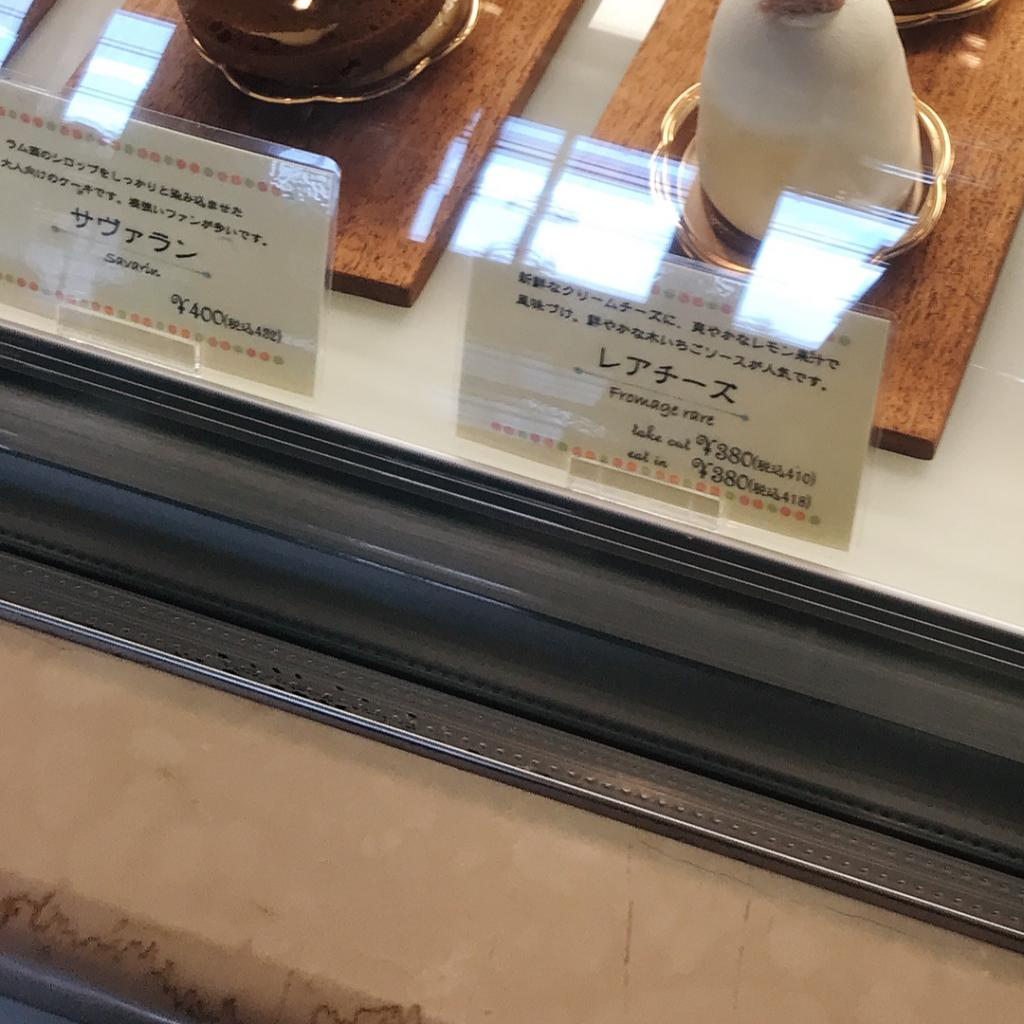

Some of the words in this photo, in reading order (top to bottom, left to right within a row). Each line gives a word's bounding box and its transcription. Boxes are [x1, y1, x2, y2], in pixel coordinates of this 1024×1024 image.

[70, 207, 198, 259] サヴァラン
[599, 346, 738, 405] レアチーズ
[609, 386, 679, 418] Fromage
